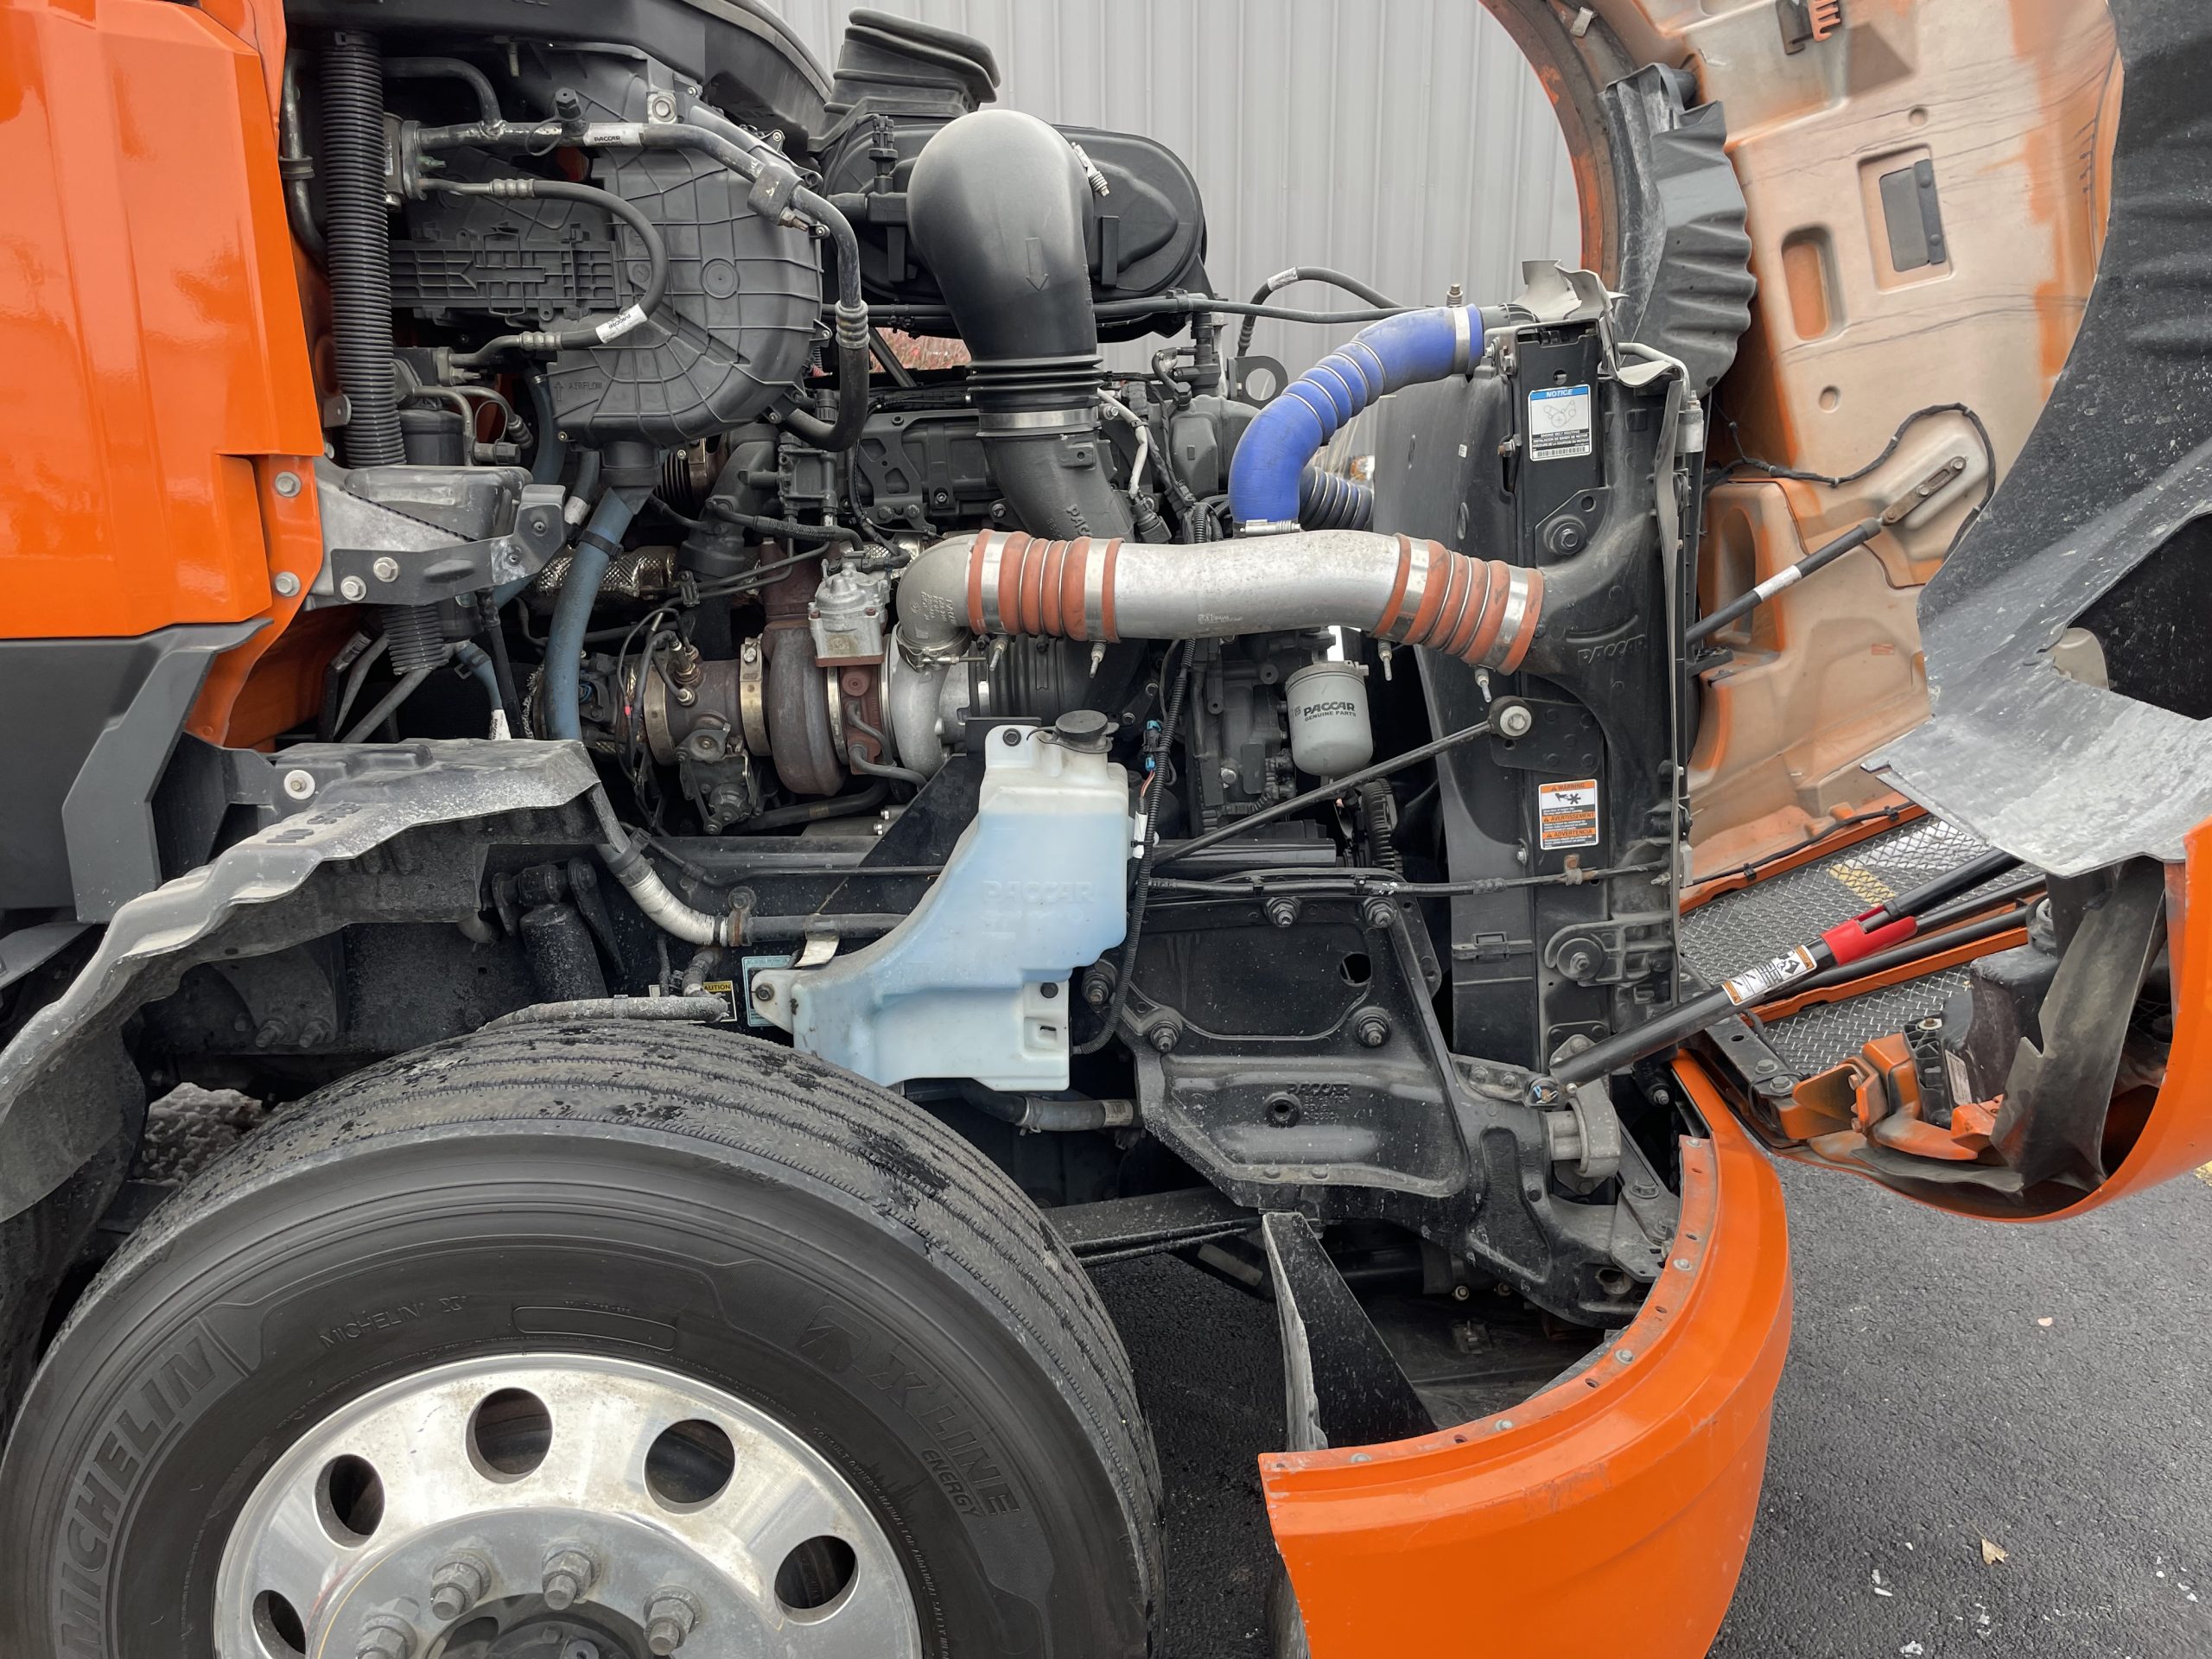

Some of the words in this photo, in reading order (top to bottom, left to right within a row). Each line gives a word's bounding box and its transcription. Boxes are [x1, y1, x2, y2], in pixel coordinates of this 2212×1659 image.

[1546, 389, 1573, 398] NOTICE
[1303, 701, 1356, 716] PACCAR
[1304, 710, 1334, 721] GENUINE
[1558, 782, 1586, 791] WARNING
[1550, 812, 1594, 821] AVERTISSEMENT
[1554, 829, 1592, 837] ADVERTENCIA
[320, 1301, 425, 1350] MICHELIN
[918, 1404, 1021, 1516] LINE
[921, 1448, 987, 1517] ENERGY
[60, 1336, 216, 1659] MICHELIN
